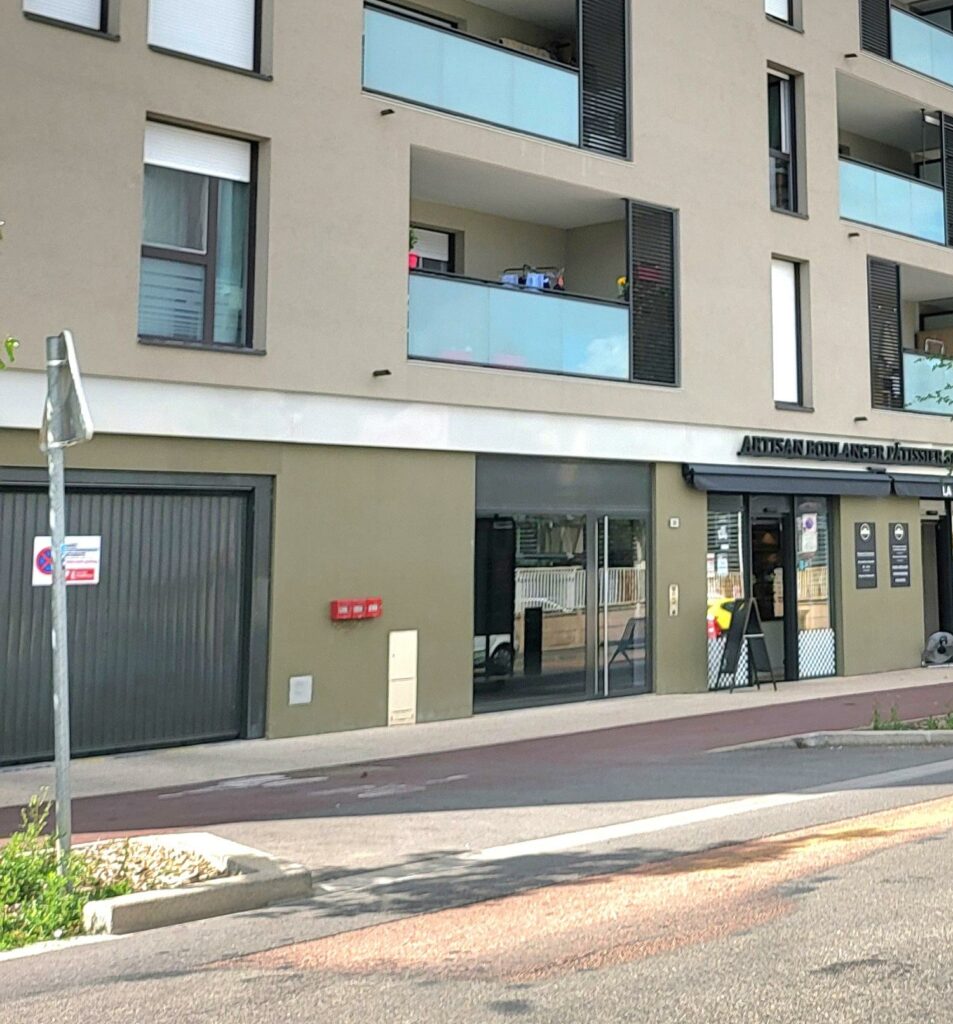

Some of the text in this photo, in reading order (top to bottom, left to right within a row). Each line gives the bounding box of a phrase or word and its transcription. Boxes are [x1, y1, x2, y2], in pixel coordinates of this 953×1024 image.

[738, 435, 803, 458] ARTISAN
[805, 440, 885, 461] BOULANGER
[942, 485, 952, 497] LA
